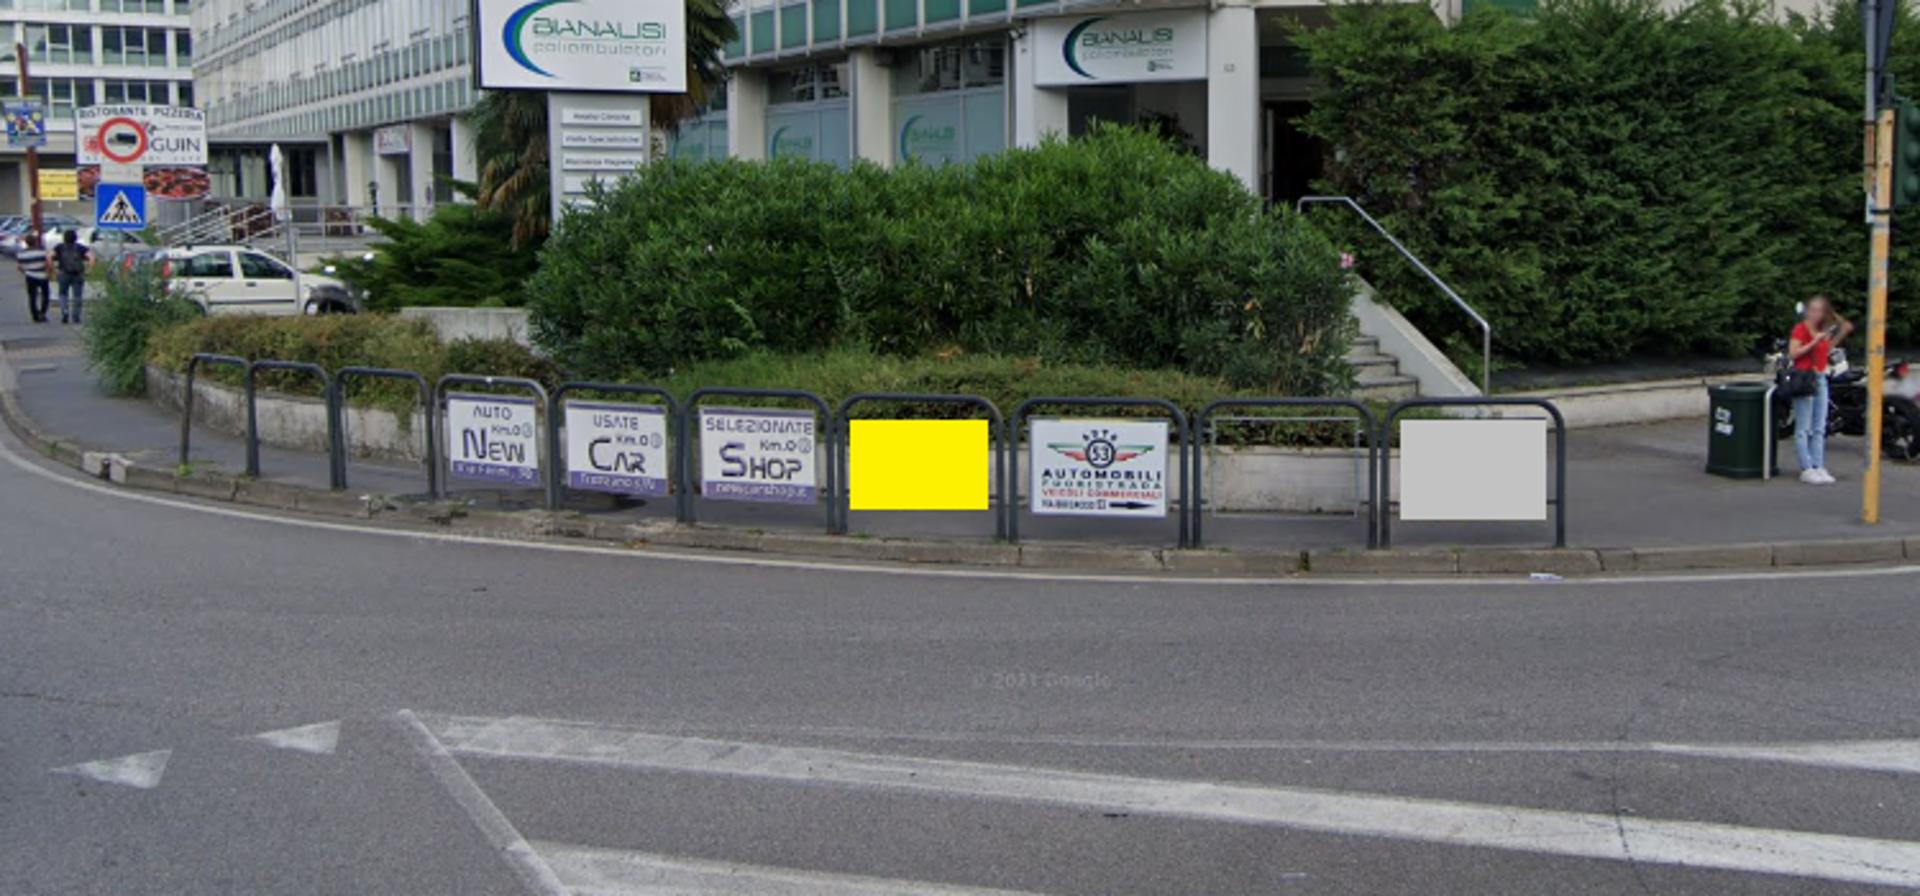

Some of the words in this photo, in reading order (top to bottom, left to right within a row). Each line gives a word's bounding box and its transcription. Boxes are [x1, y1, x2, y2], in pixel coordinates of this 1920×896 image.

[532, 17, 667, 39] BIANALISI
[1082, 27, 1174, 48] BIANALISI
[152, 106, 203, 121] PIZZERIA
[149, 137, 201, 153] GUIN
[473, 405, 513, 421] AUTO
[593, 414, 639, 431] USATE
[705, 416, 814, 436] SELEZIONATE
[1091, 444, 1111, 462] 53
[1041, 467, 1161, 481] AUTOMOBILI
